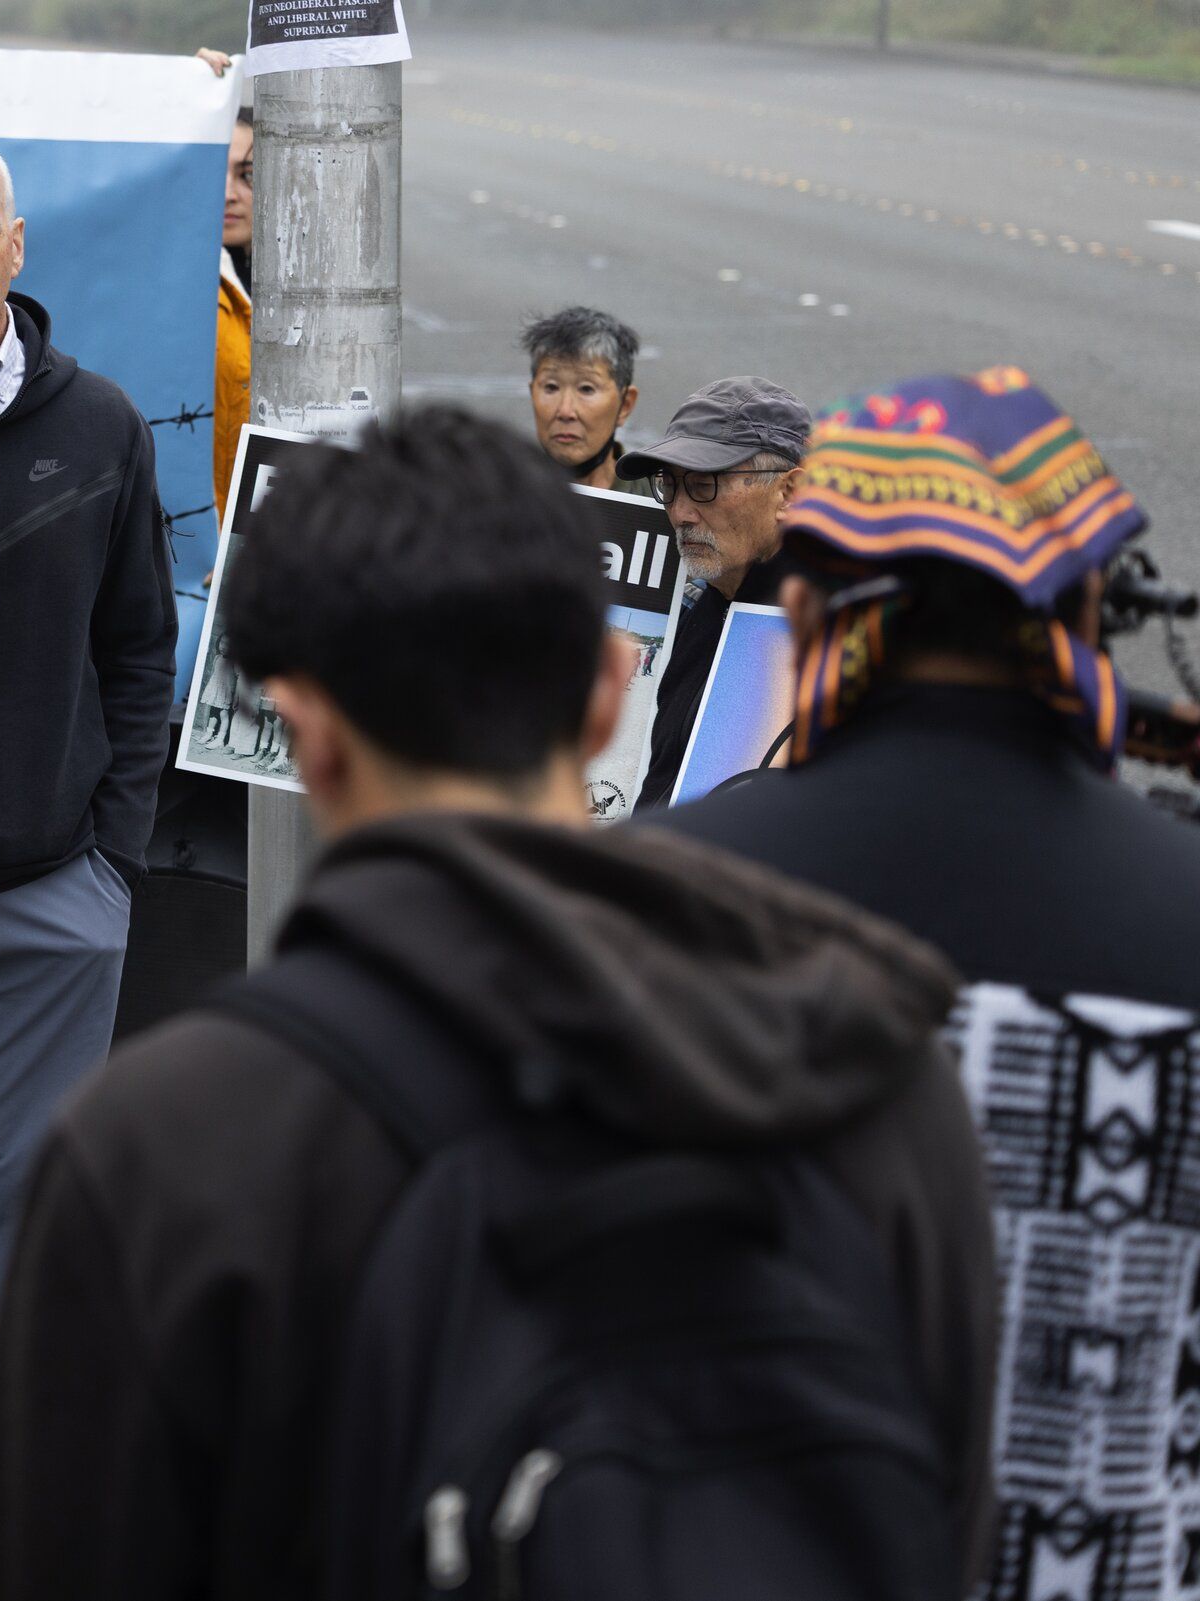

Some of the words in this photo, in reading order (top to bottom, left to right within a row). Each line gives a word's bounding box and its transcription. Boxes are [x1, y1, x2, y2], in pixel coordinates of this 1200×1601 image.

[274, 0, 336, 12] NEOLIBERAL
[268, 16, 286, 26] AND
[287, 12, 330, 24] LIBERAL
[331, 9, 368, 20] WHITE
[284, 24, 348, 38] SUPREMACY
[34, 459, 59, 471] NIKE
[600, 779, 626, 808] SOLIDARITY
